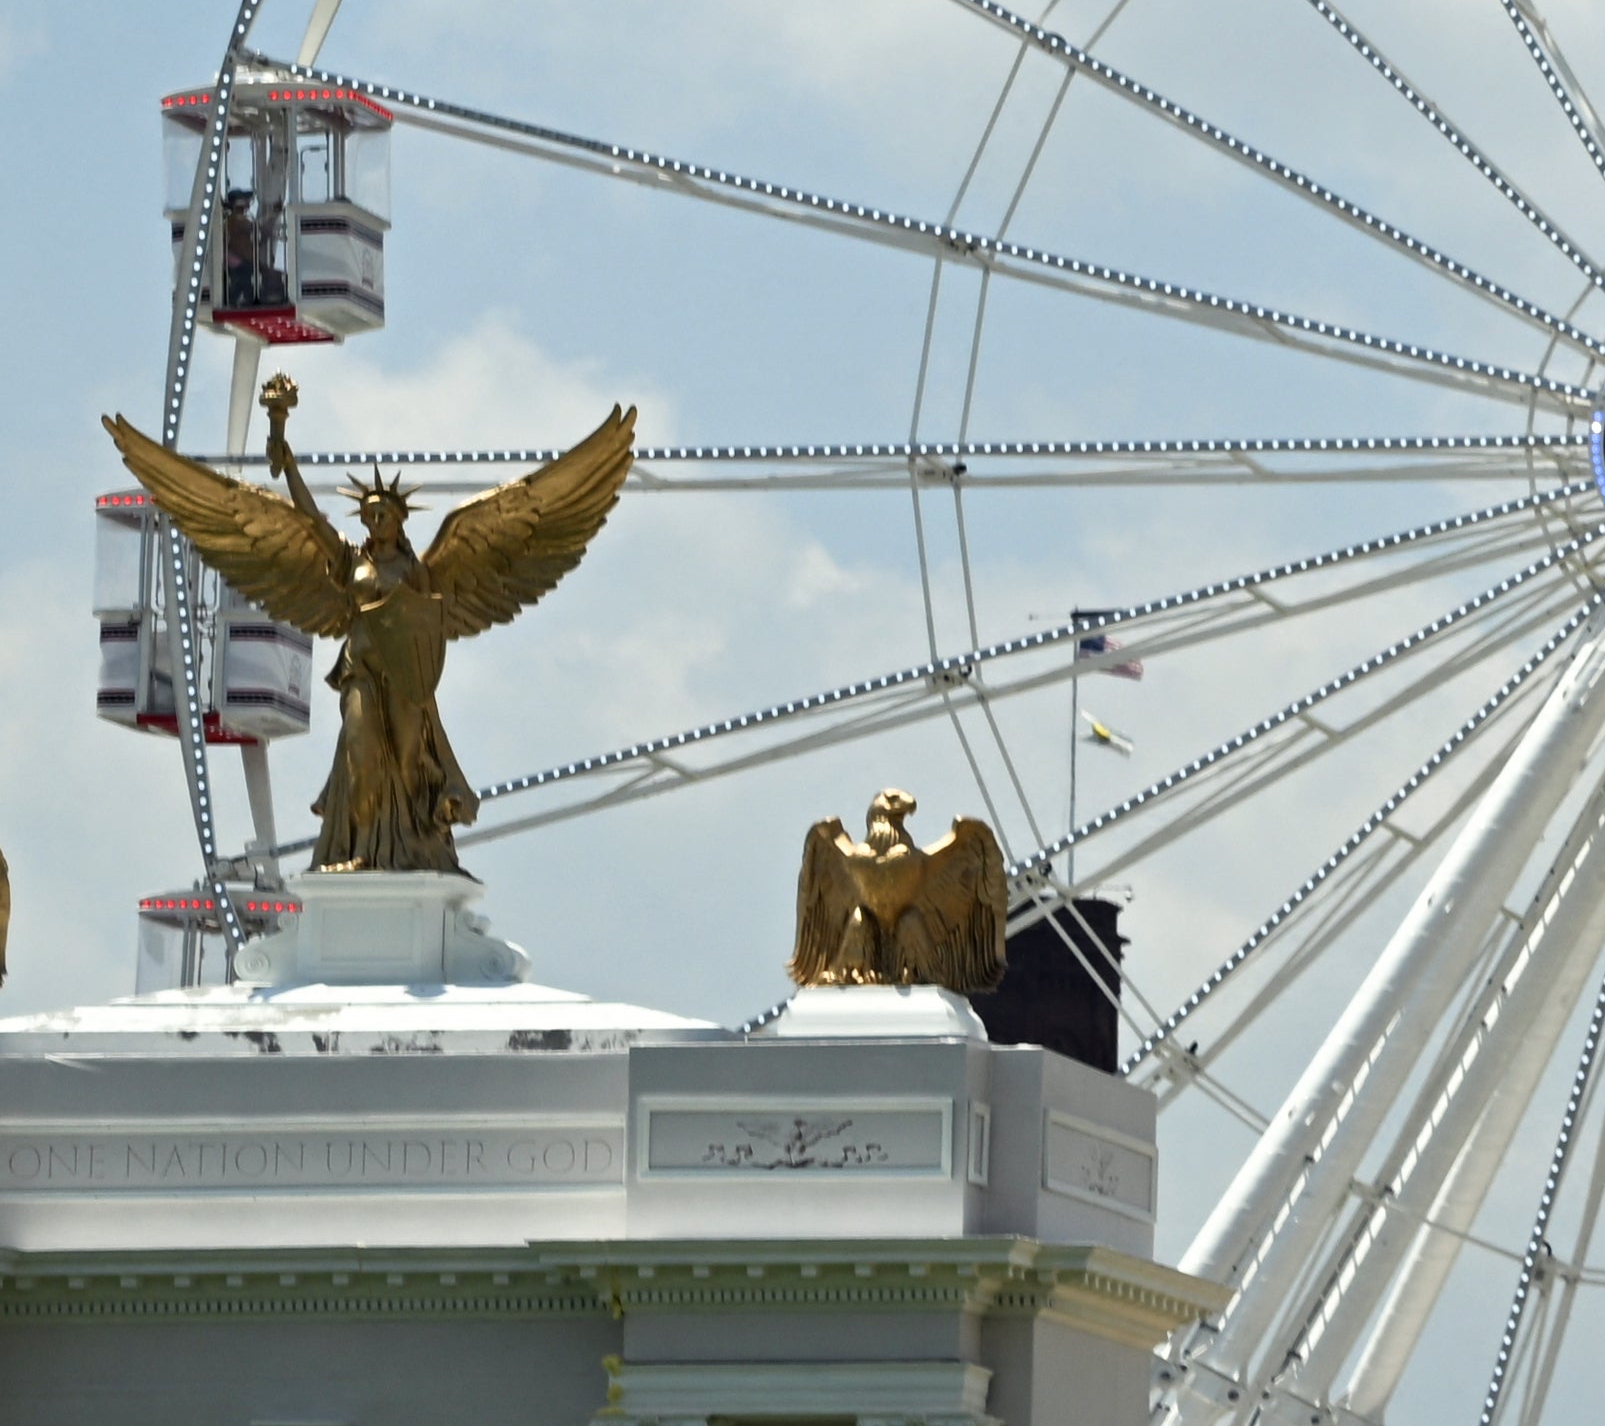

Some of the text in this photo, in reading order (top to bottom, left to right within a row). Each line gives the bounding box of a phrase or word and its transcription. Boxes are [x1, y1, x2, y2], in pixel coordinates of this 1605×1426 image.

[8, 1138, 613, 1180] ONE NATION UNDER GOD
